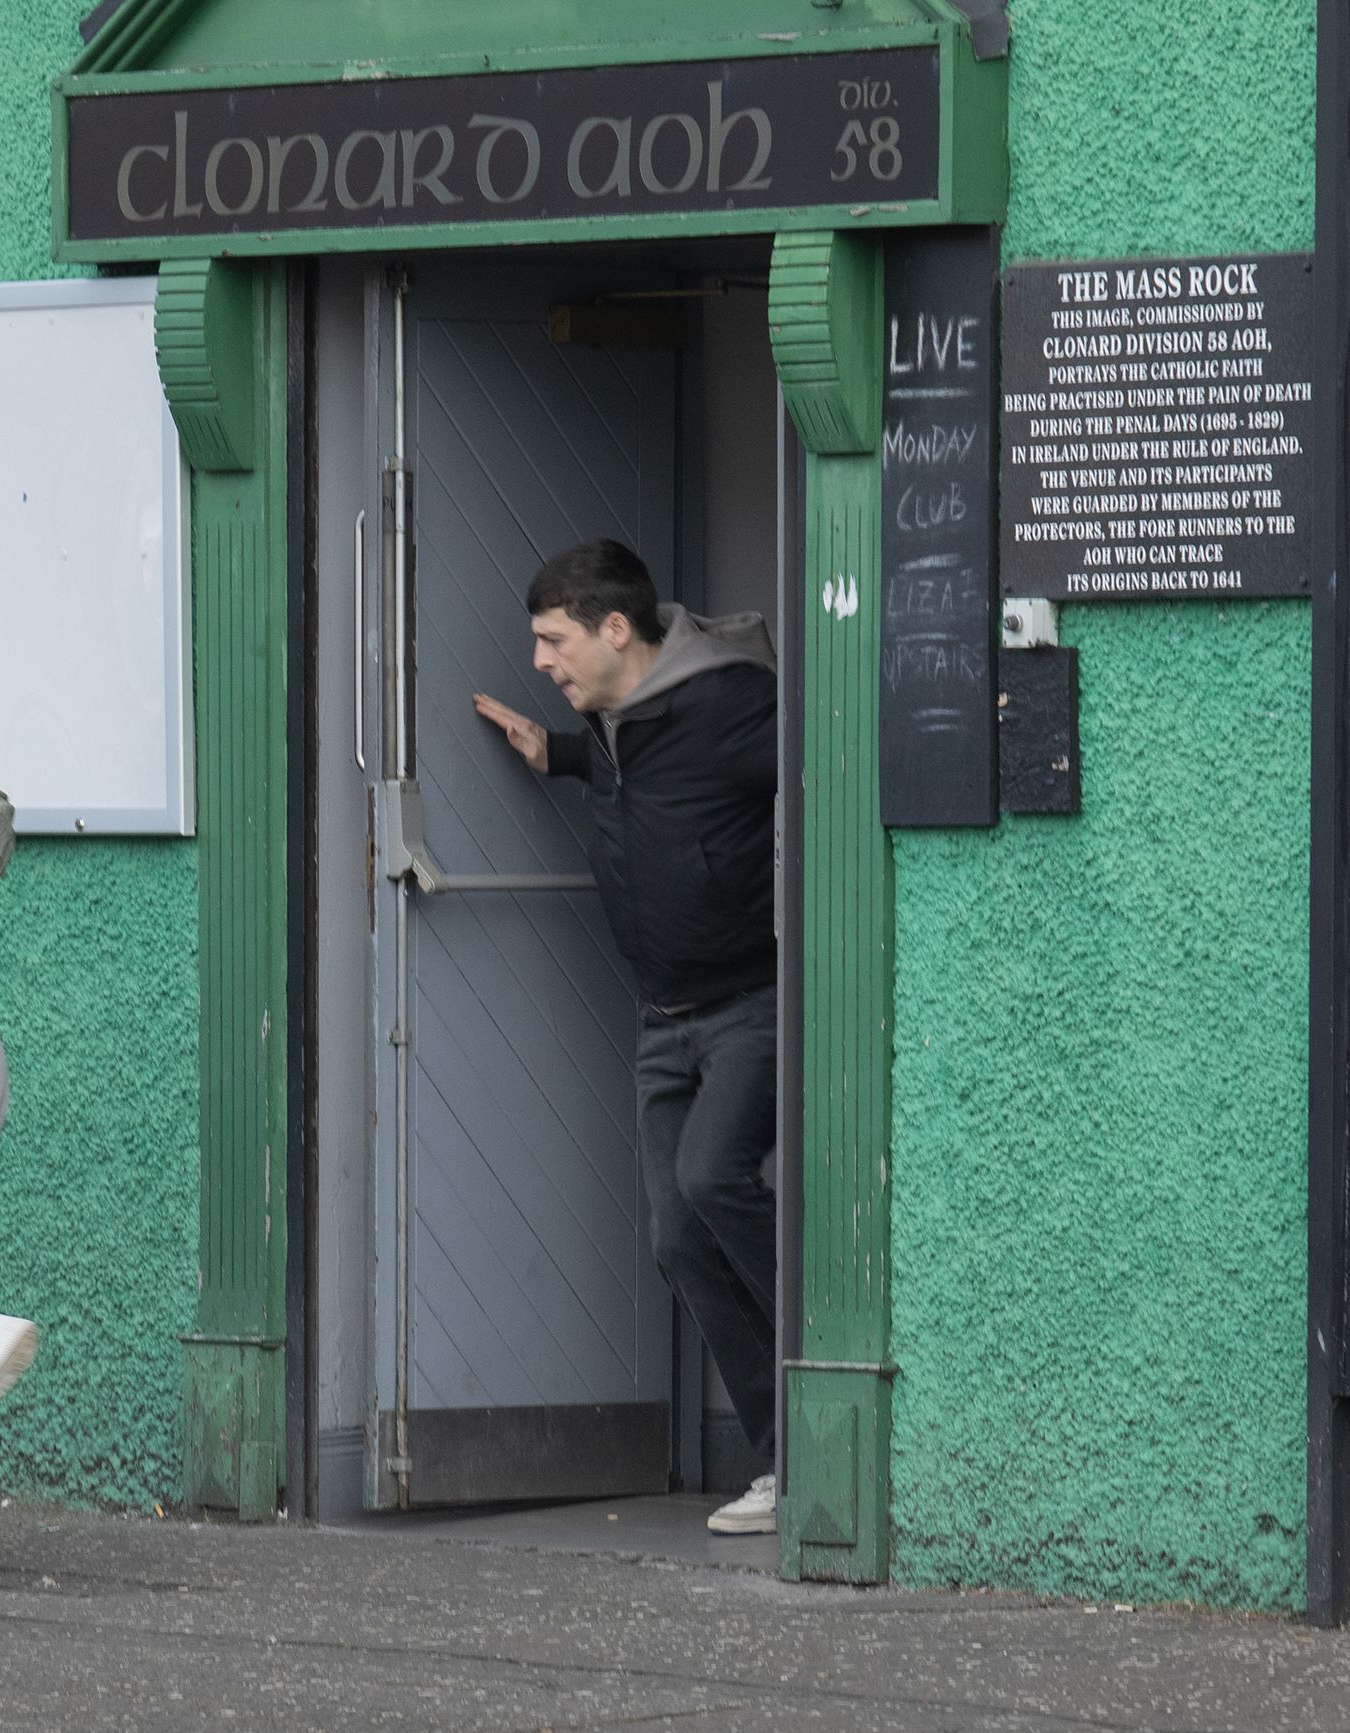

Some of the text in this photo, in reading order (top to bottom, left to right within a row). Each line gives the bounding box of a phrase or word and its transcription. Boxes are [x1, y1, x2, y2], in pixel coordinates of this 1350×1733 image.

[830, 116, 902, 181] 58
[1058, 264, 1258, 302] THE MASS ROCK
[1052, 302, 1264, 329] THIS IMAGE, COMMISSIONED BY
[890, 312, 979, 373] LIVE
[1043, 328, 1272, 359] CLONARD DIVISION 58 AOH,
[1049, 358, 1263, 384] PORTRAYS THE CATHOLIC FAITH
[1005, 382, 1312, 412] BEING PRACTISED UNDER THE PAIN OF DEATH
[1030, 417, 1082, 437] DURING
[1086, 417, 1113, 435] THE
[1117, 415, 1160, 434] PENAL
[1164, 413, 1197, 432] DAYS
[882, 419, 977, 470] MONDAY
[1012, 436, 1303, 464] IN IRELAND UNDER THE RULE OF ENGLAND.
[1040, 463, 1273, 488] THE VENUE AND ITS PARTICIPANTS
[897, 482, 966, 531] CLUB
[1031, 489, 1282, 515] WERE GUARDED BY MEMBERS OF THE
[1015, 516, 1295, 541] PROTECTORS, THE FORE RUNNERS TO THE
[1083, 544, 1223, 565] AOH WHO CAN TRACE
[1067, 570, 1242, 592] ITS ORIGINS BACK TO 1641
